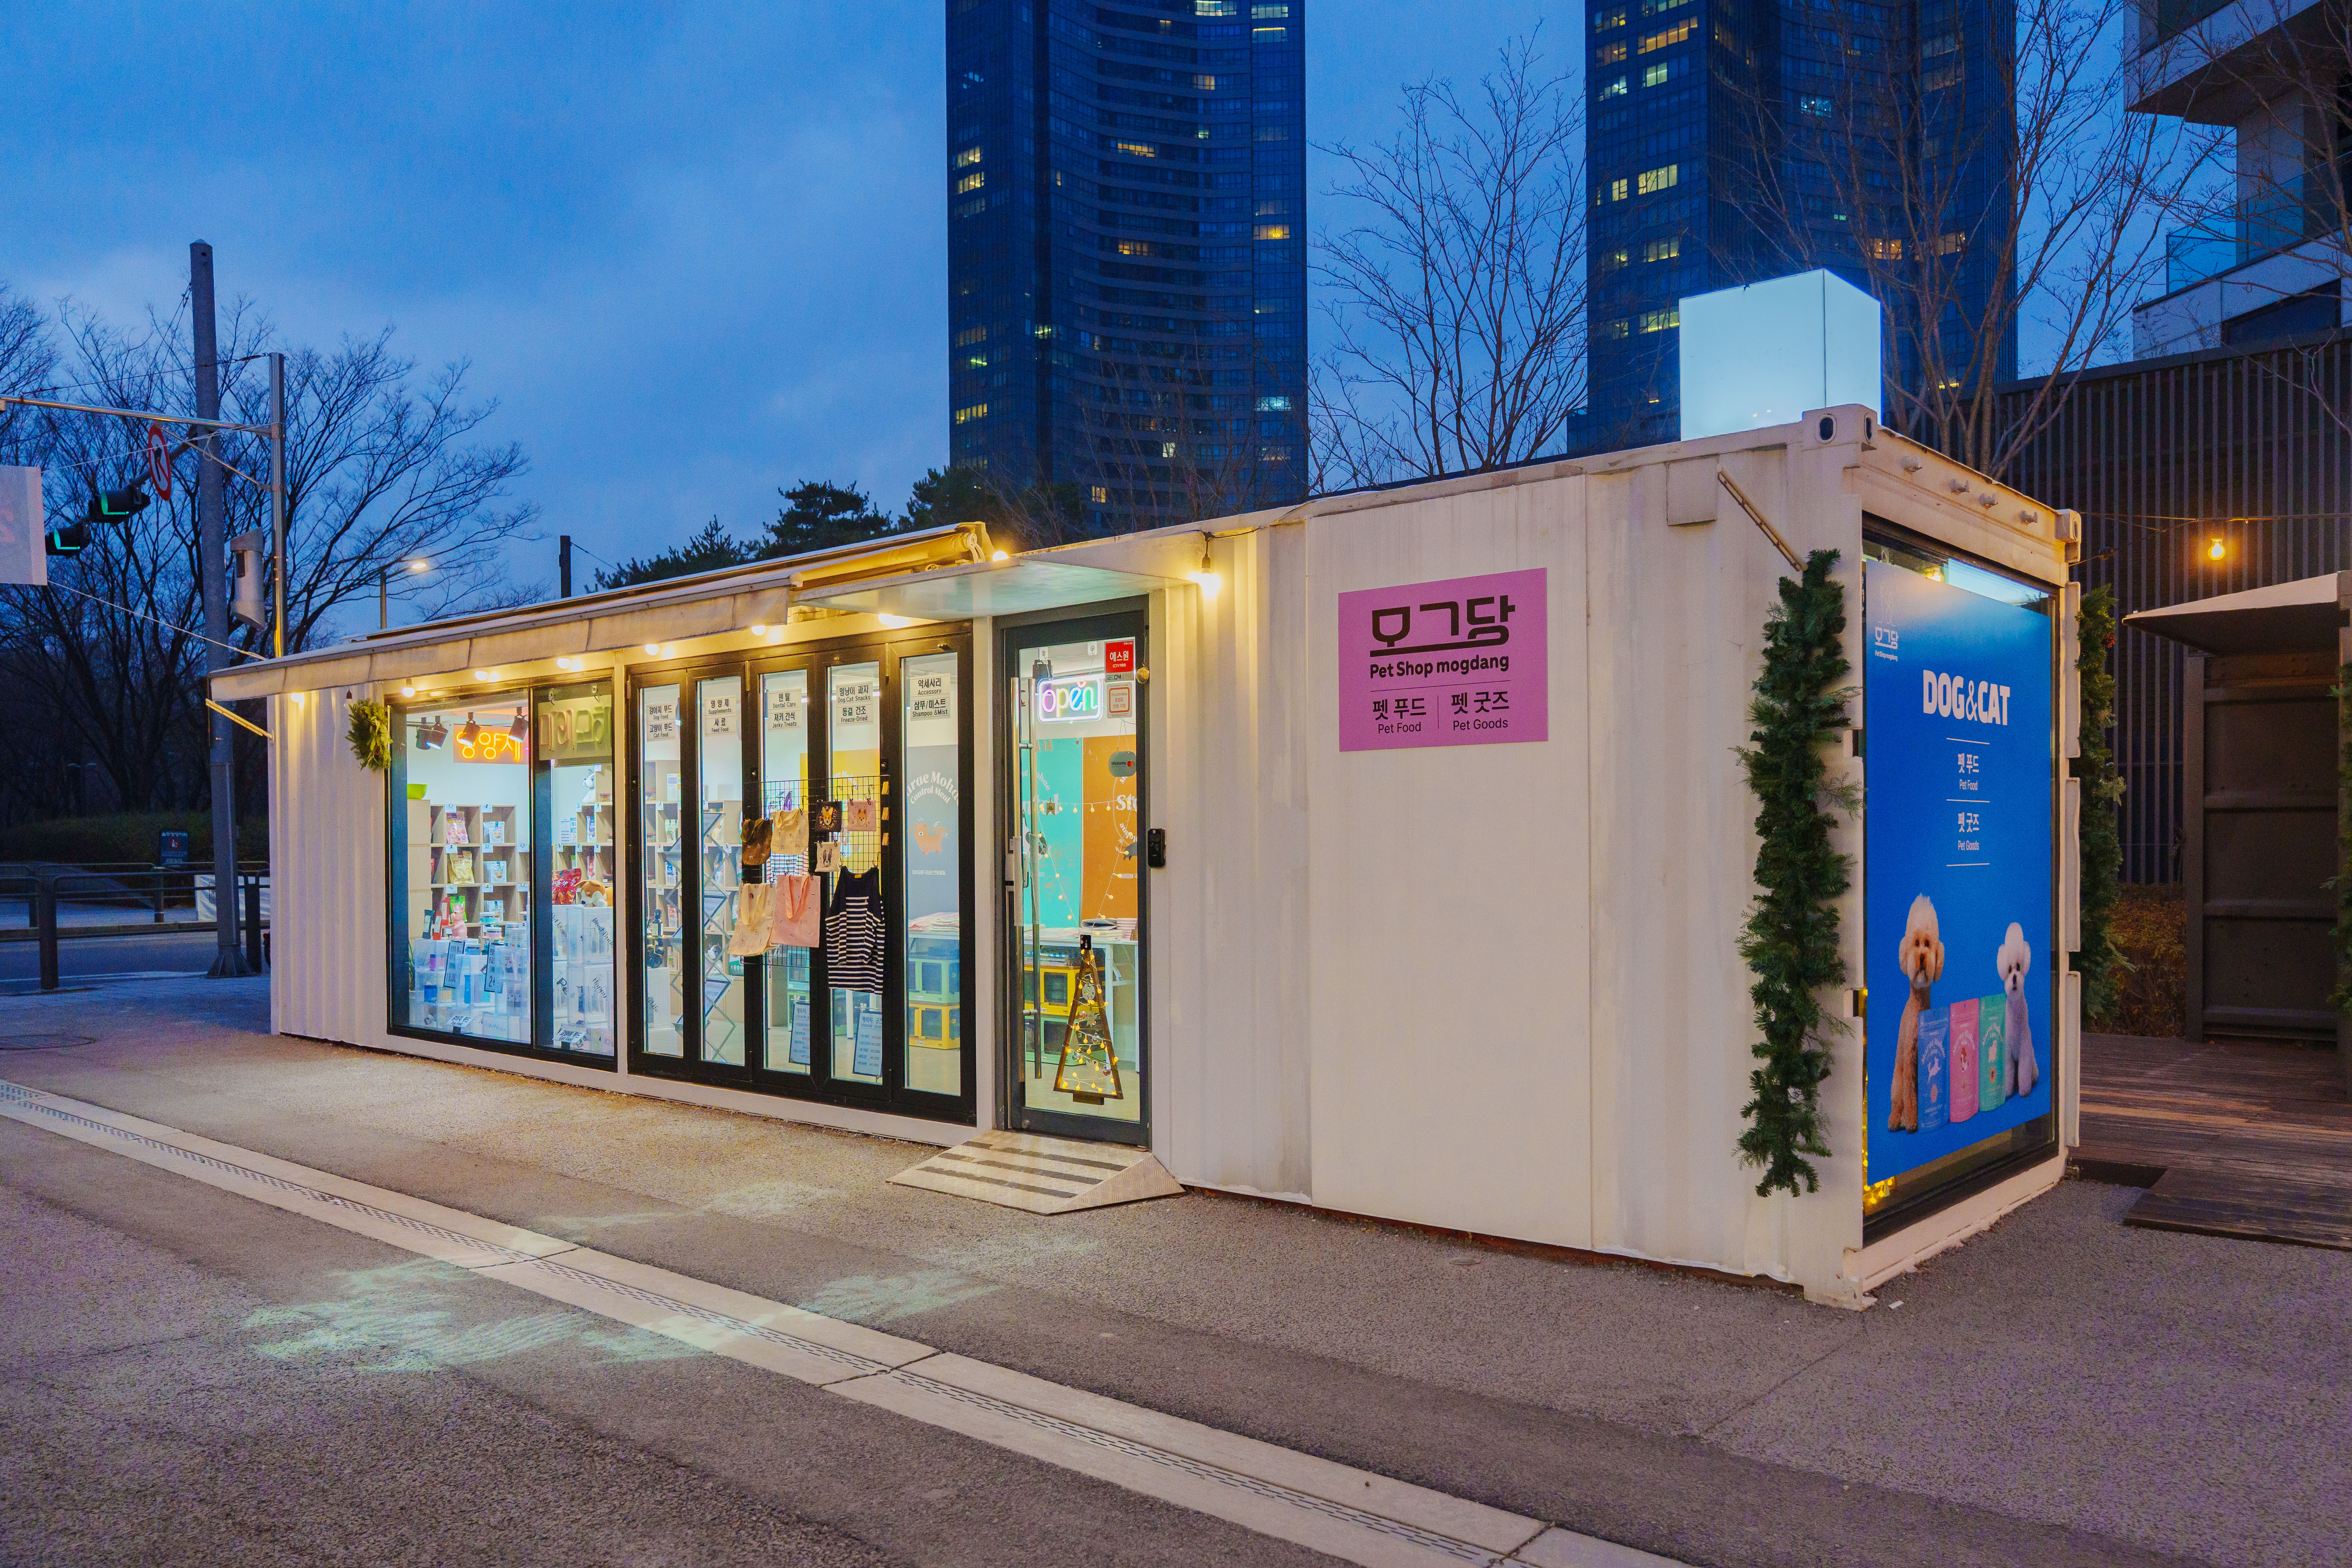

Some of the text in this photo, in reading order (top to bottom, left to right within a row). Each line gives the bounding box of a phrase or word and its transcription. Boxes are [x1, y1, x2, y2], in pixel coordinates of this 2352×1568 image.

[1110, 651, 1129, 662] 에스원
[1370, 655, 1509, 678] Pet Shop mogdang
[918, 678, 941, 688] 악세사리
[840, 685, 869, 696] 멍냥이 과자
[1451, 690, 1509, 715] 펫 굿즈
[1923, 670, 2010, 725] DOG&CAT
[649, 706, 662, 715] 강아지
[914, 699, 946, 710] 삼푸/미스트
[1372, 697, 1426, 721] 펫 푸드
[842, 706, 866, 716] 동결 건조
[649, 724, 662, 732] 고양이
[1378, 722, 1421, 734] Pet Food
[1453, 718, 1508, 731] Pet Goods
[1042, 740, 1052, 752] 14
[1958, 753, 1979, 775] 펫 푸드
[1967, 780, 1978, 791] Food
[911, 786, 950, 804] Control Meal
[1958, 812, 1979, 833] 펫 굿즈
[1966, 840, 1979, 852] Goods
